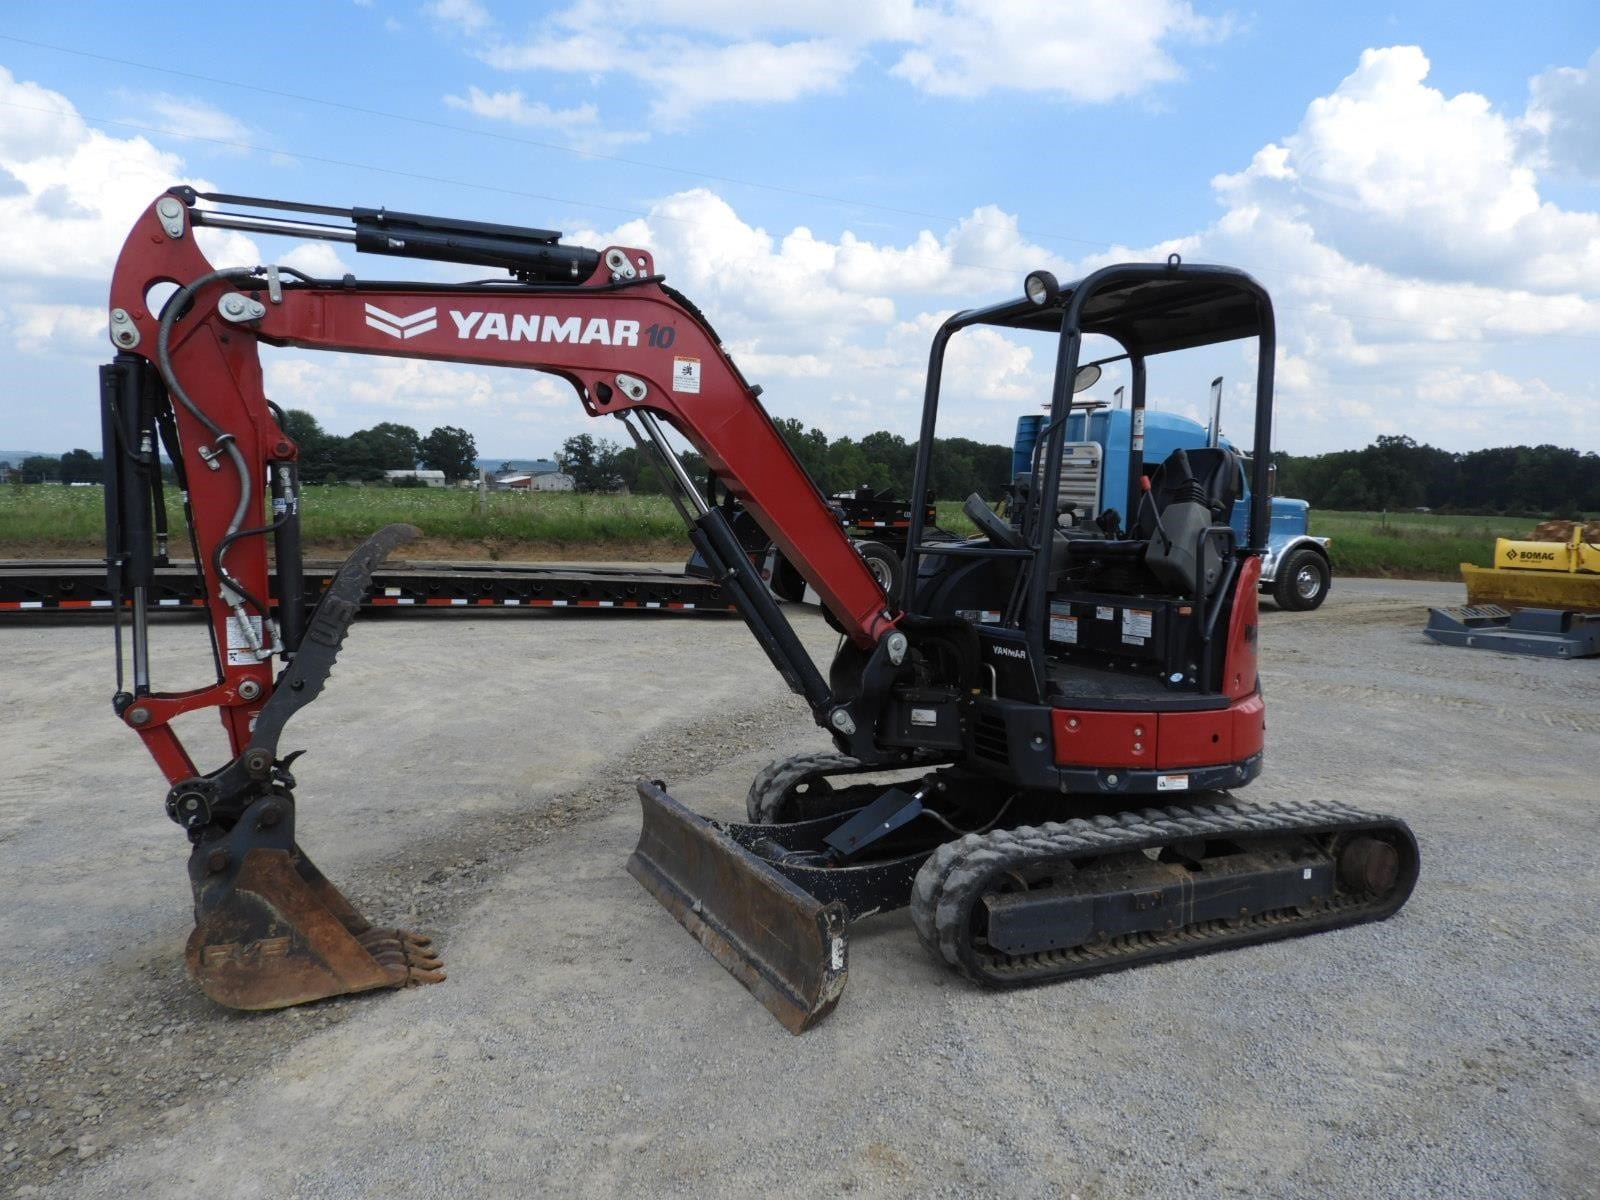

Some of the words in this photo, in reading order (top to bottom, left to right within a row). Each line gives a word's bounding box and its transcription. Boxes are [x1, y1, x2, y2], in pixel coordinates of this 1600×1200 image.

[449, 311, 640, 346] YANMAR
[644, 323, 675, 349] 10
[1520, 551, 1554, 560] BOMAG
[992, 645, 1026, 659] YANMAR
